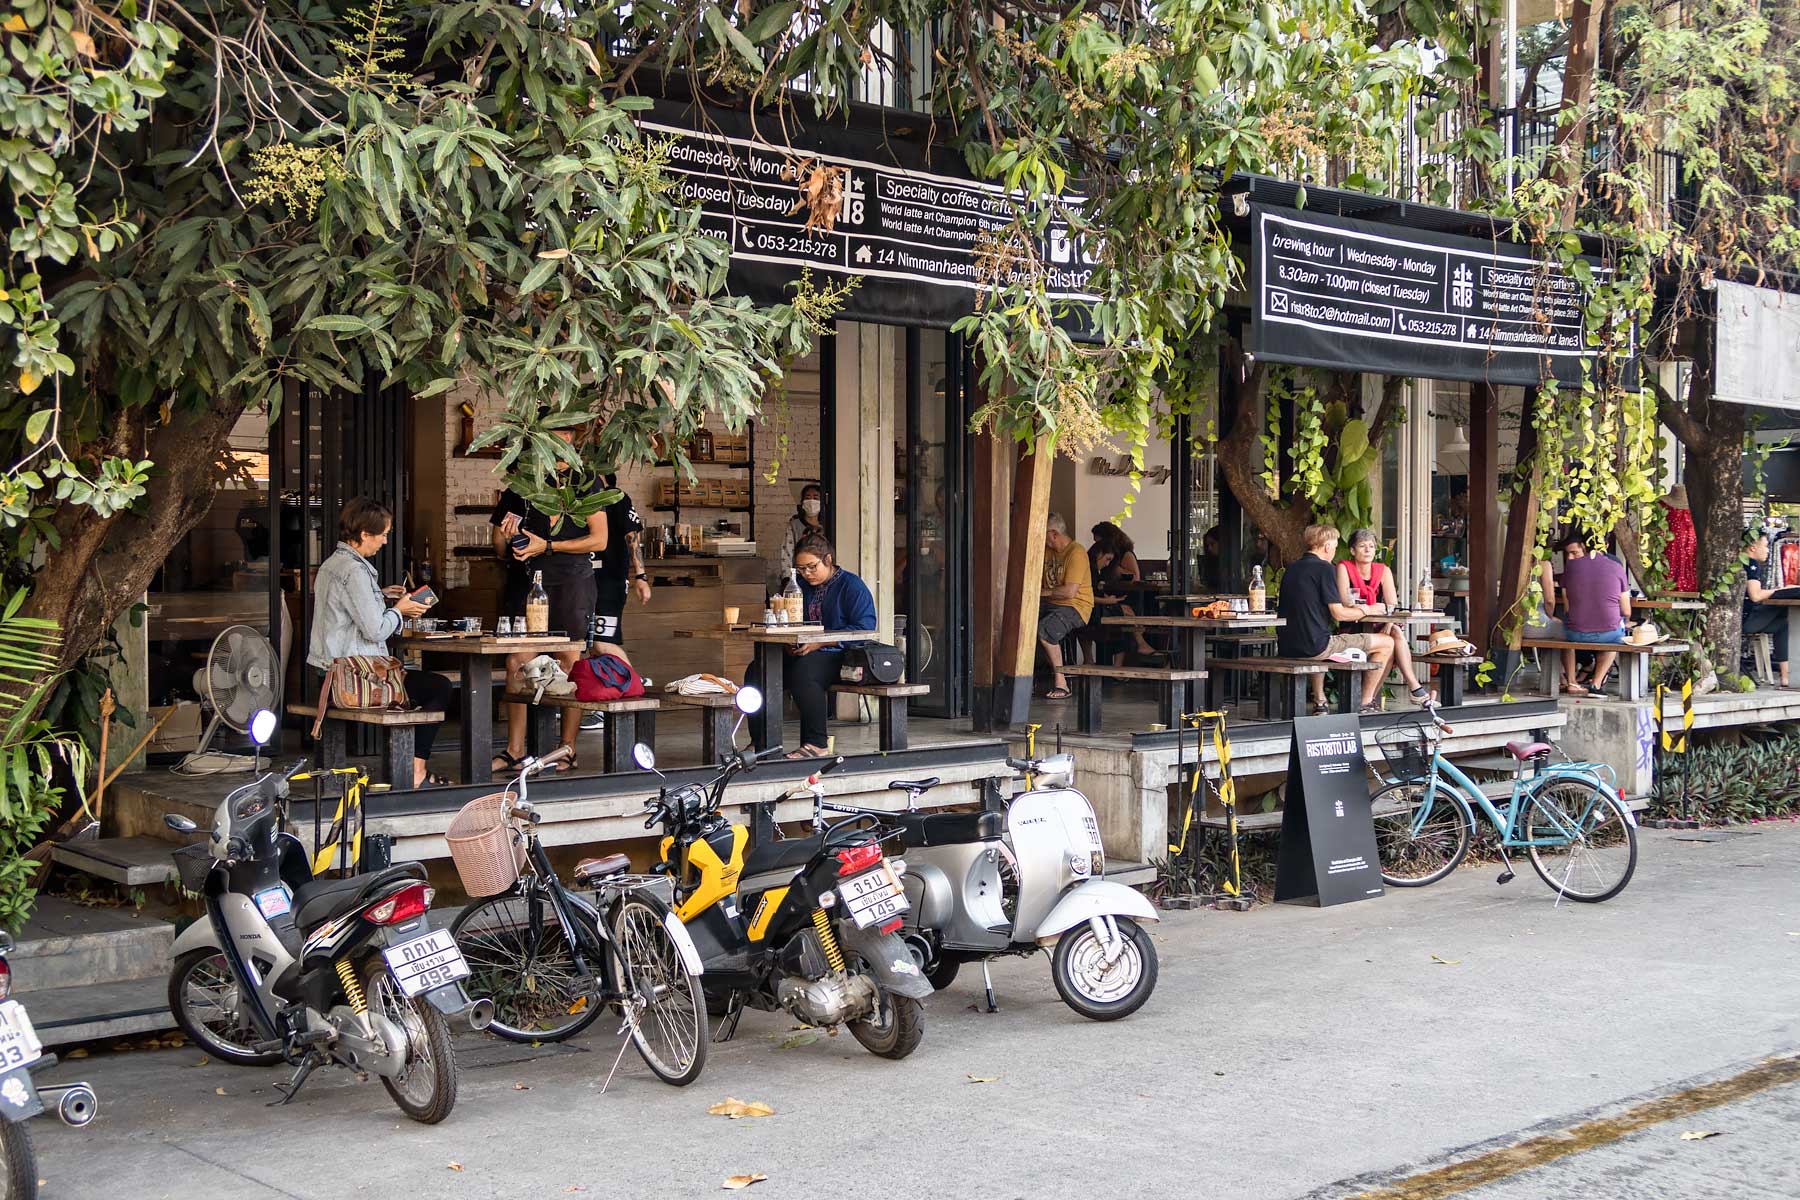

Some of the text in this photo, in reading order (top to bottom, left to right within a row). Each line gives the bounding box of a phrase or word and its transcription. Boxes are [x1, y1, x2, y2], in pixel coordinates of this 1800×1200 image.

[735, 189, 796, 215] Tuesday)
[886, 179, 940, 205] Specialty
[941, 191, 979, 208] coffee
[881, 202, 902, 216] World
[904, 206, 923, 219] latte
[924, 211, 935, 221] art
[935, 211, 977, 227] Champion
[978, 218, 990, 229] 6th
[881, 217, 902, 231] World
[904, 221, 923, 234] latte
[923, 225, 935, 236] Art
[935, 226, 977, 241] Champion
[757, 233, 838, 259] 053-215-278
[876, 249, 895, 264] 14
[1272, 233, 1311, 257] brewing
[1312, 242, 1335, 258] hour
[1347, 248, 1398, 271] Wednesday
[1402, 257, 1437, 277] Monday
[1278, 265, 1319, 285] 8.30am
[1325, 273, 1360, 292] 7.00pm
[1361, 279, 1392, 297] (closed
[1392, 284, 1430, 304] Tuesday)
[1487, 269, 1523, 287] Specialty
[1290, 300, 1391, 328] ristr8to2@hotmail.com
[1408, 319, 1457, 336] 053-215-278
[1478, 327, 1491, 339] 14
[1342, 740, 1358, 754] LAB
[868, 899, 896, 919] 145
[239, 933, 262, 941] HONDA
[419, 965, 454, 987] 492
